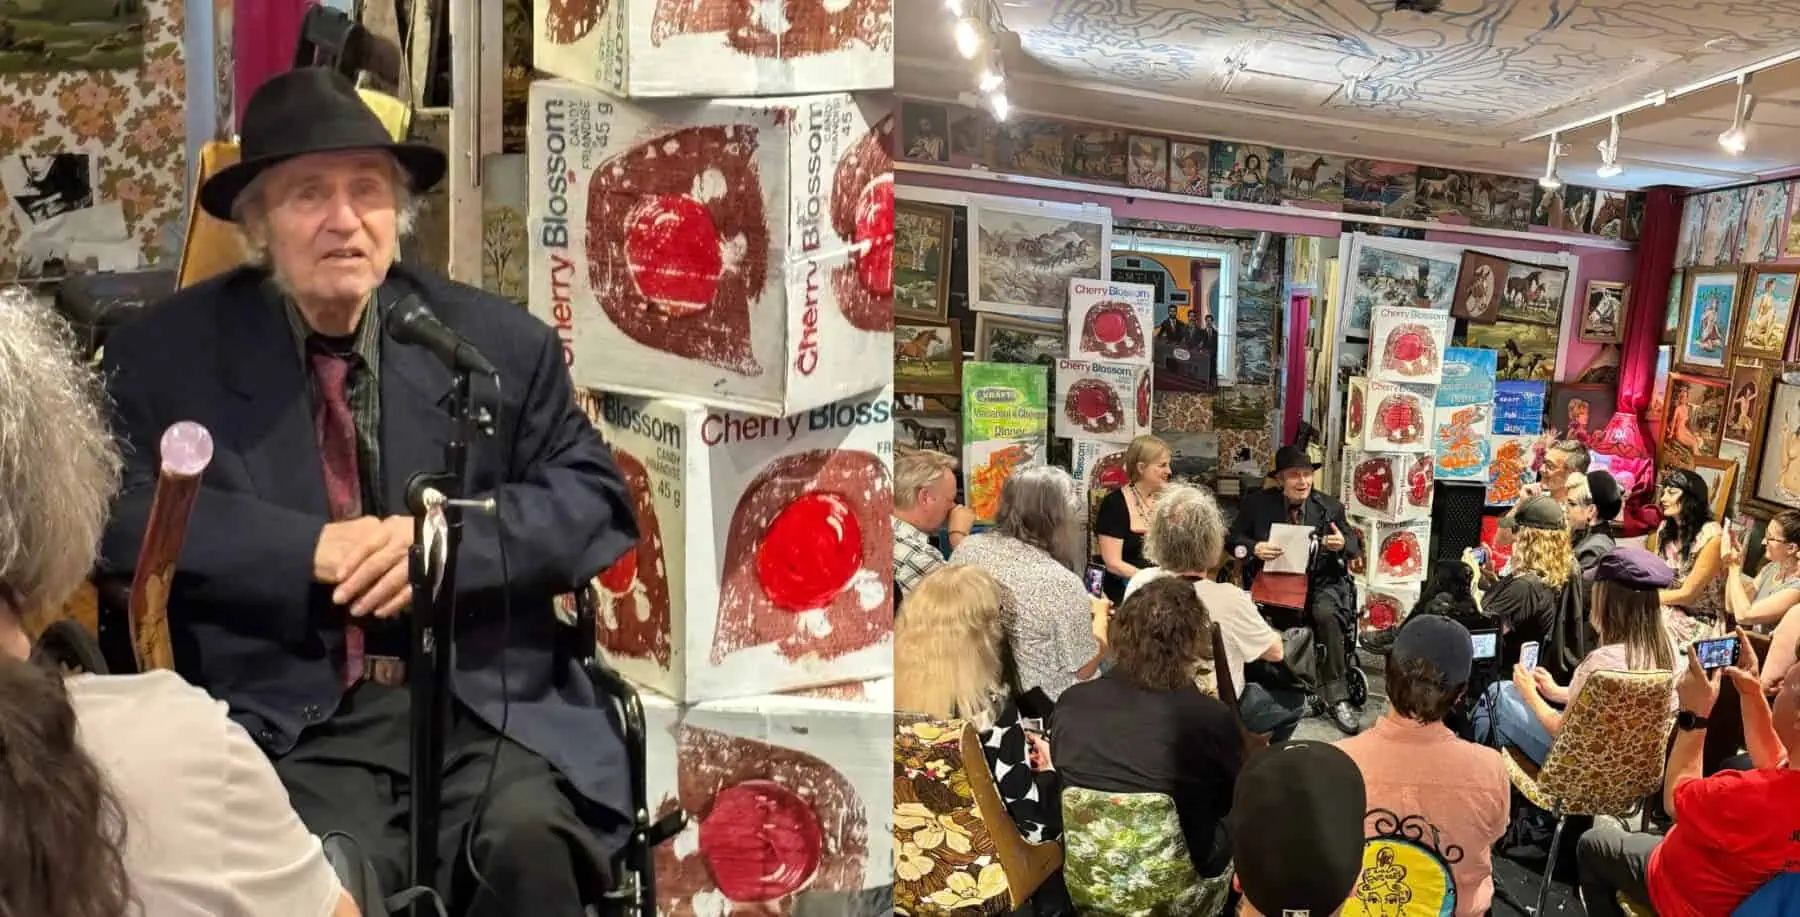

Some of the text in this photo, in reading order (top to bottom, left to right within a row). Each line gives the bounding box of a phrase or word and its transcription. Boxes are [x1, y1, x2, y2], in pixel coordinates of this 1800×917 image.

[568, 101, 580, 147] CANDY
[580, 98, 592, 170] FRIANDISE
[542, 98, 568, 248] Blossom
[803, 101, 822, 252] Blossom
[1075, 283, 1107, 296] Cherry
[1380, 308, 1409, 318] Cherry
[1060, 359, 1132, 377] Cherry Blossom
[604, 397, 681, 449] Blossom
[701, 399, 895, 447] Cherry Bloss
